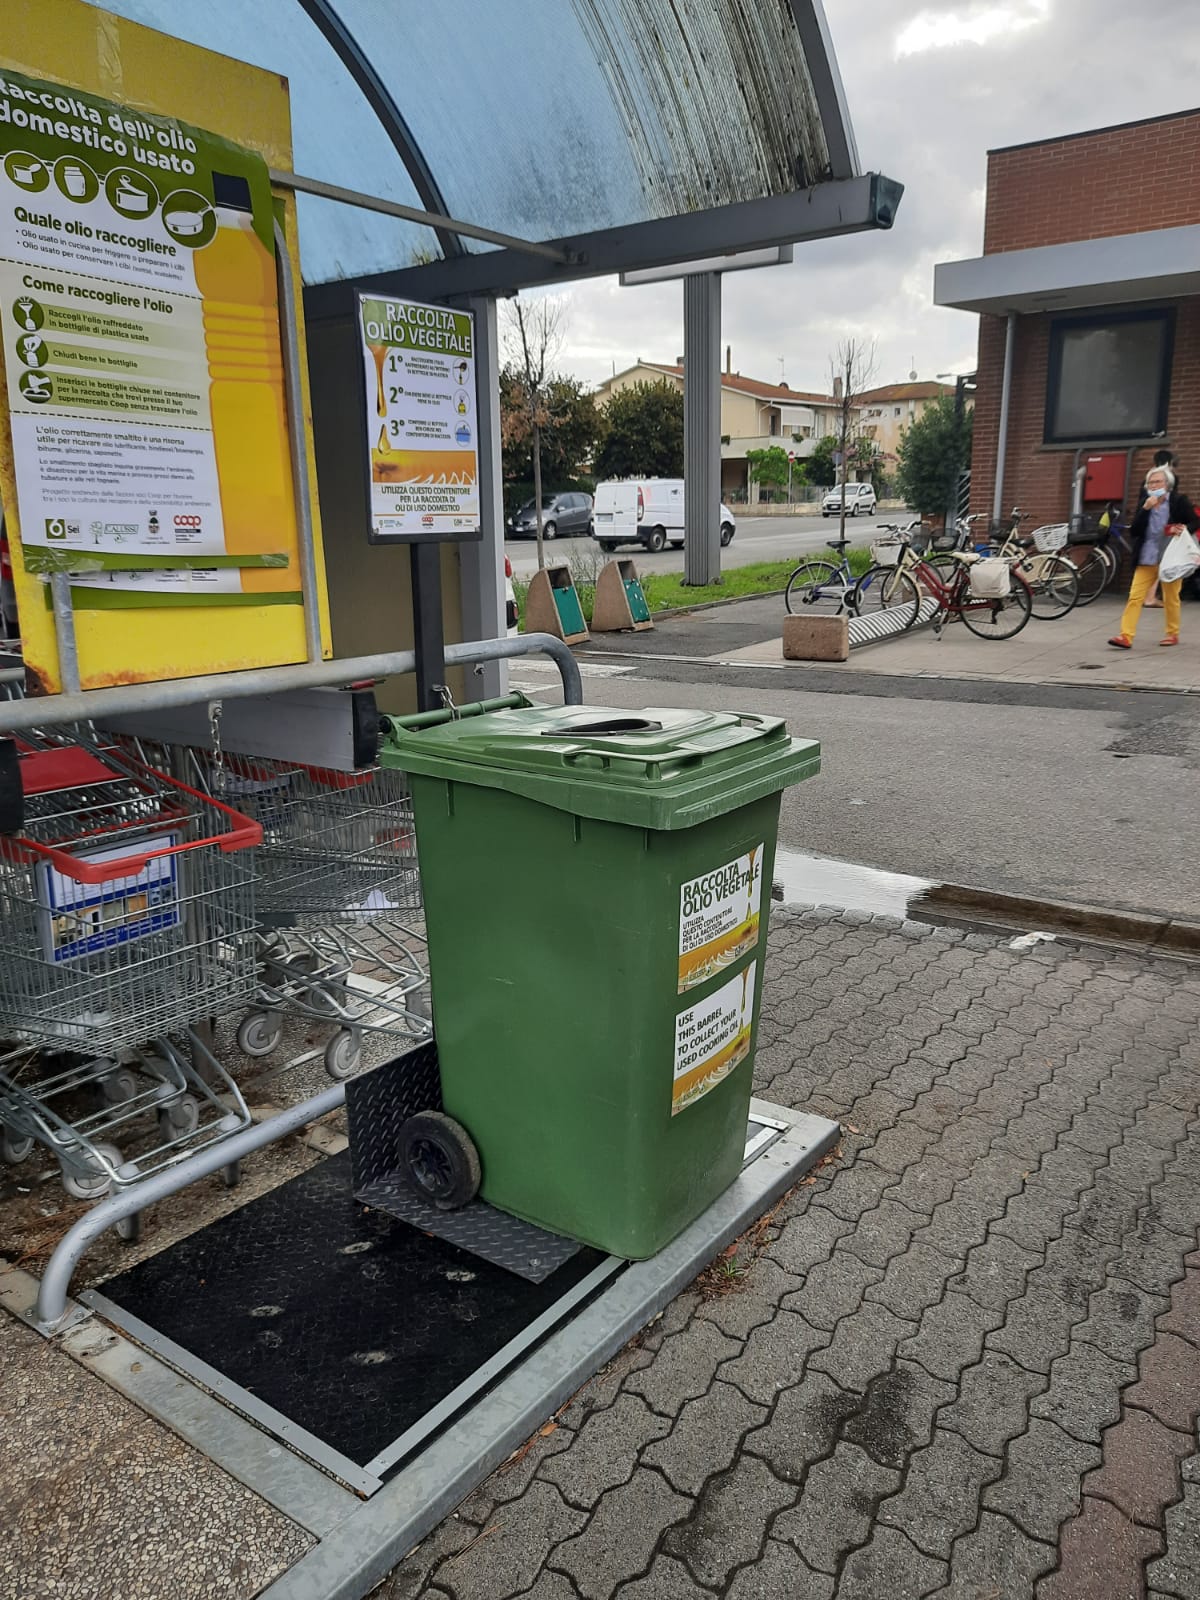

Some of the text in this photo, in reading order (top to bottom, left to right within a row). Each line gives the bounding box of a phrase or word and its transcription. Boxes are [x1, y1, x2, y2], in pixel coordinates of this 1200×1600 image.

[0, 100, 196, 175] domestico usato
[107, 112, 197, 154] dell'olio
[14, 206, 177, 257] Quale olio raccogliere
[21, 229, 37, 240] Olio
[38, 235, 59, 245] usato
[60, 238, 67, 246] in
[68, 241, 91, 251] cucina
[92, 246, 103, 255] per
[22, 241, 39, 251] Olio
[40, 246, 61, 256] usato
[62, 250, 74, 261] per
[75, 253, 114, 267] conservare
[22, 275, 173, 314] Come raccogliere l'olio
[48, 309, 81, 322] Raccogli
[102, 320, 144, 332] raffreddato
[385, 303, 456, 331] RACCOLTA
[58, 321, 91, 334] bottiglie
[101, 328, 130, 341] plastica
[366, 321, 472, 353] OLIO VEGETALE
[52, 350, 77, 360] Chiudi
[78, 353, 97, 363] bene
[107, 358, 138, 369] bottiglie
[56, 376, 88, 387] Inserisci
[89, 380, 96, 388] le
[97, 381, 128, 392] bottiglie
[128, 385, 151, 395] chiuse
[57, 386, 70, 394] per
[80, 388, 110, 399] raccolta
[111, 391, 124, 400] che
[58, 394, 109, 407] supermercato
[110, 400, 130, 410] Coop
[130, 403, 150, 411] senza
[36, 426, 60, 435] L'olio
[61, 428, 113, 439] correttamente
[36, 435, 56, 443] utile
[72, 439, 101, 447] ricavare
[381, 486, 471, 496] UTILIZZA QUESTO CONTENITORE
[399, 495, 456, 504] PER LA RACCOLTA DI
[395, 504, 460, 512] OLI DI USO DOMESTICO
[67, 525, 80, 534] Sei
[173, 515, 202, 529] coop
[682, 862, 760, 918] OLIO VEGETALE
[683, 862, 740, 902] RACCOLTA
[682, 915, 705, 930] UTILIZZA
[682, 922, 704, 938] QUESTO
[682, 934, 693, 945] PER
[693, 931, 700, 941] LA
[682, 943, 689, 953] DI
[677, 1007, 723, 1042] THIS BARREL
[678, 1011, 694, 1027] USE
[677, 1008, 737, 1057] TO COLLECT YOUR
[676, 1051, 698, 1071] USED
[698, 1027, 729, 1057] COOKING
